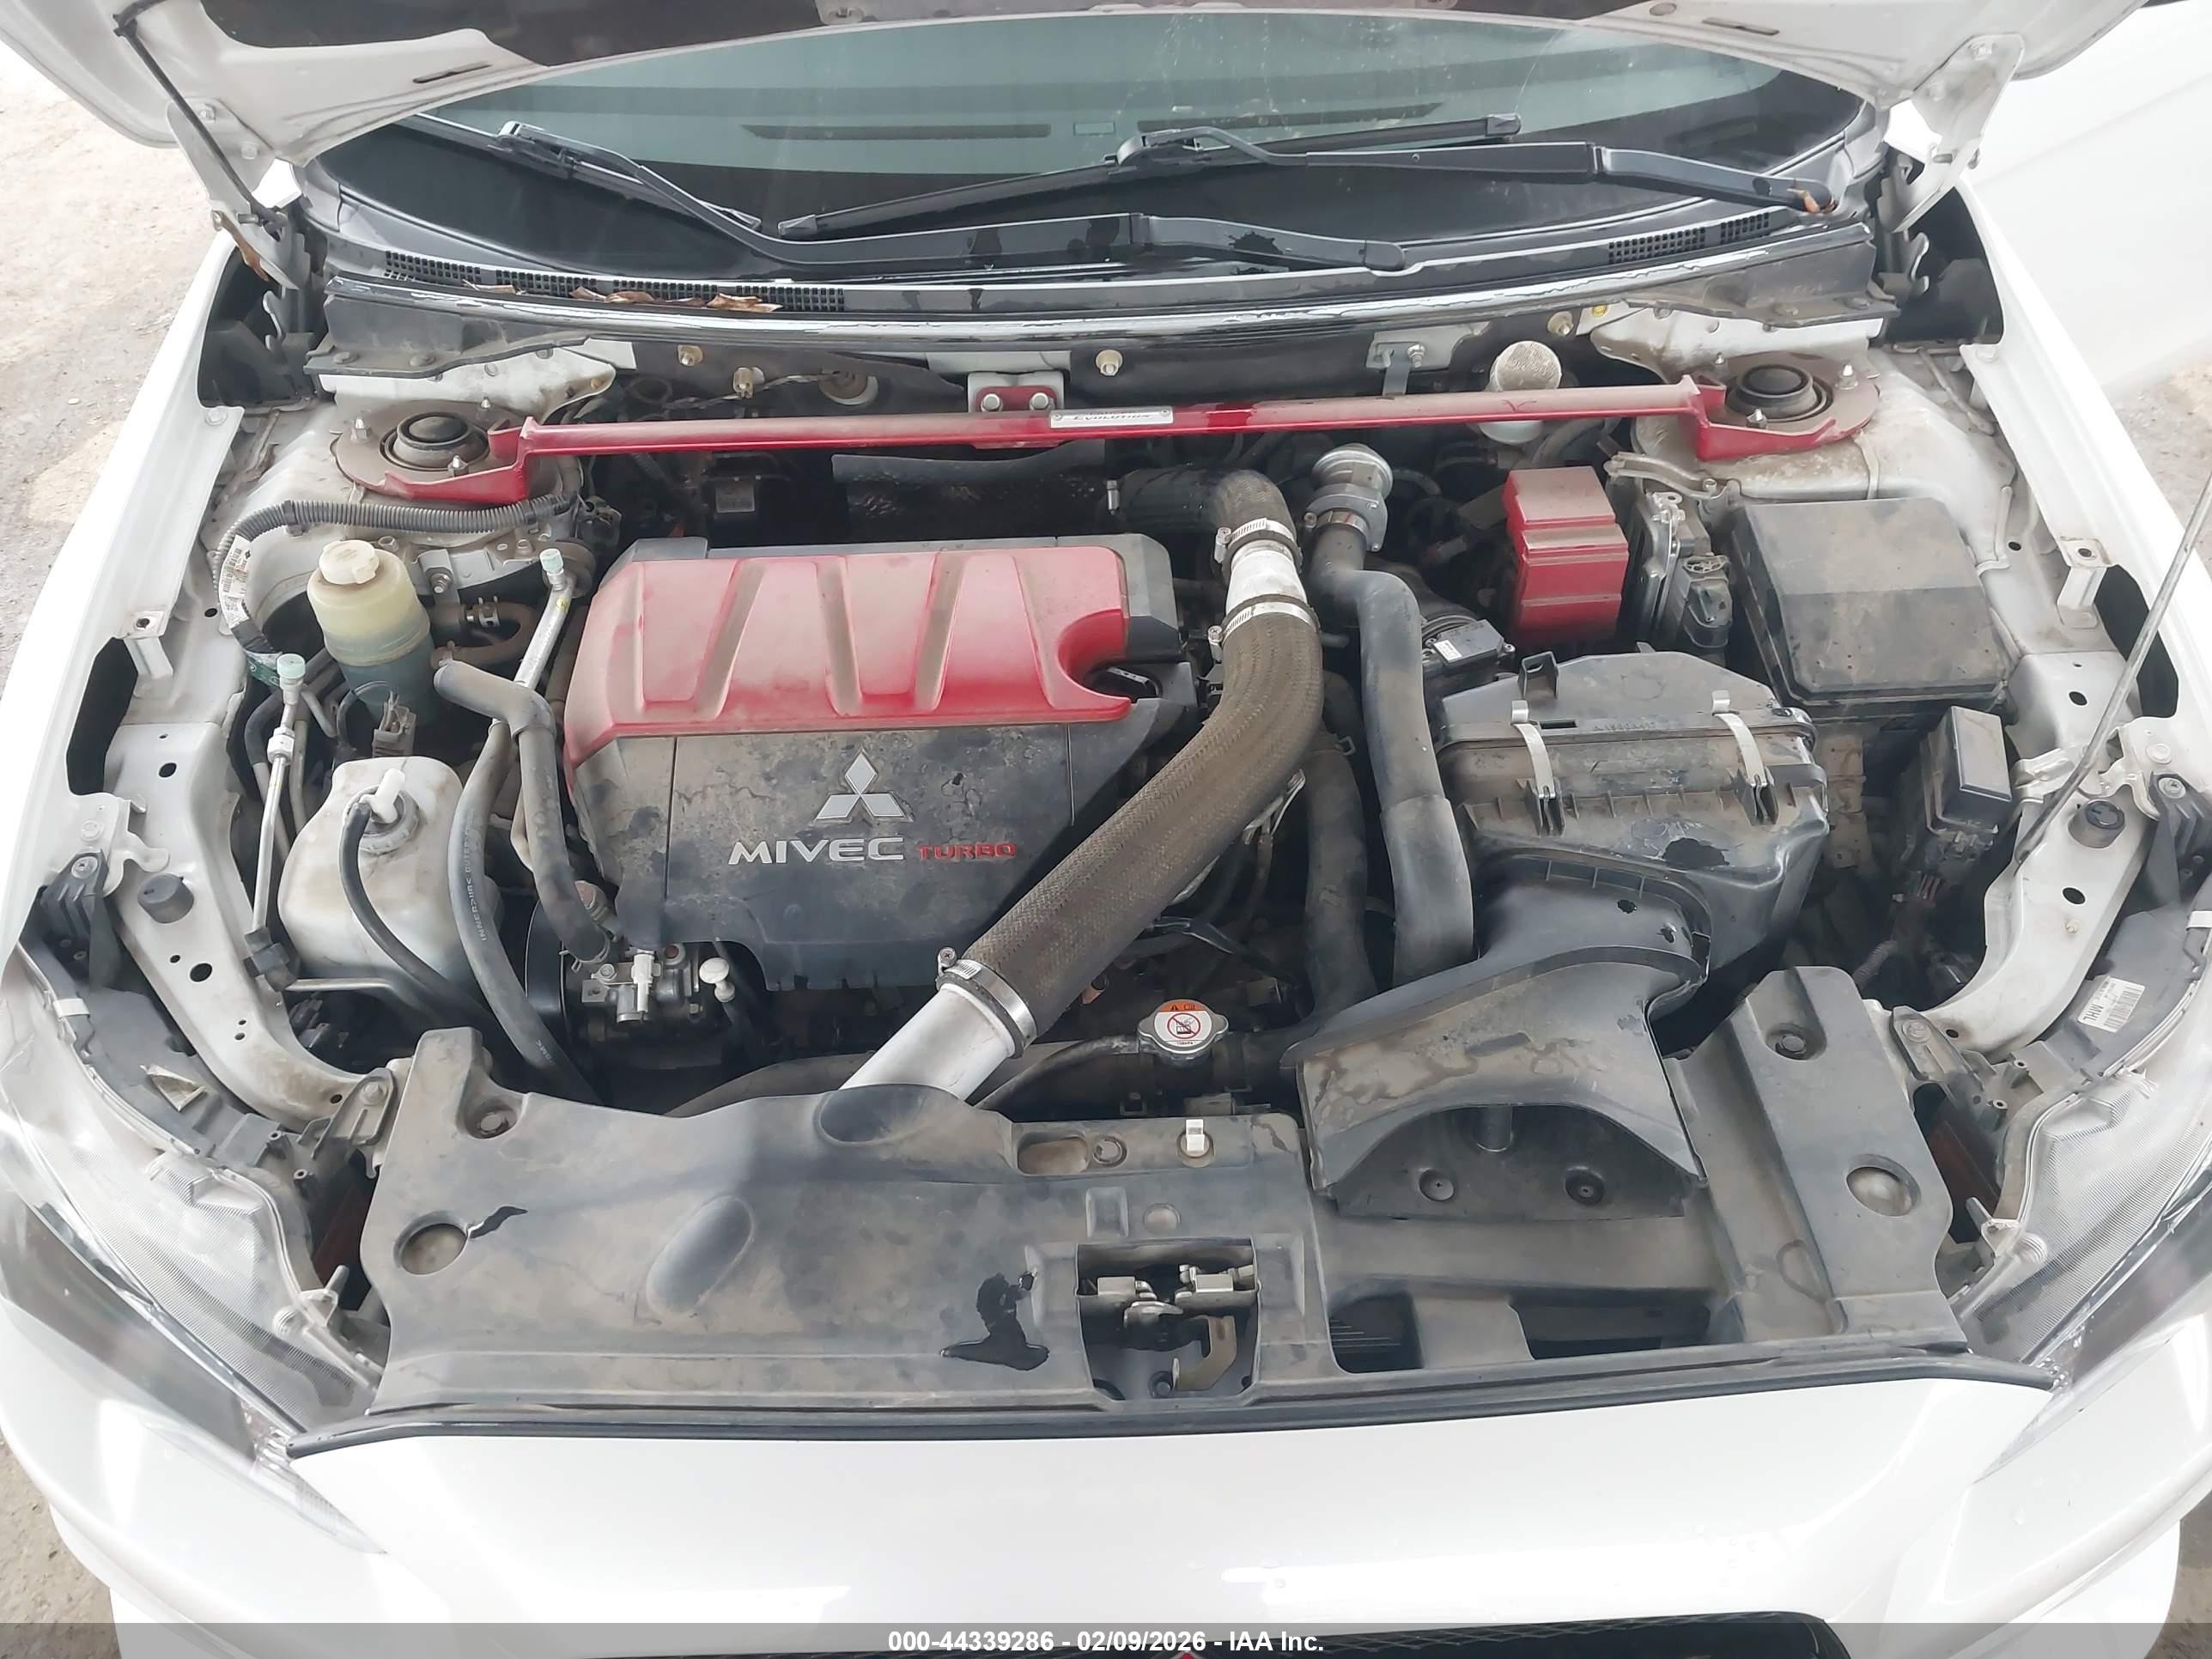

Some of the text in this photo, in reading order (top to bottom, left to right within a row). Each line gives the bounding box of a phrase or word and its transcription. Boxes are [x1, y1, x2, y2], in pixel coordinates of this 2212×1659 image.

[728, 836, 1018, 865] MIVEC TURBO
[2082, 1003, 2104, 1021] MHL
